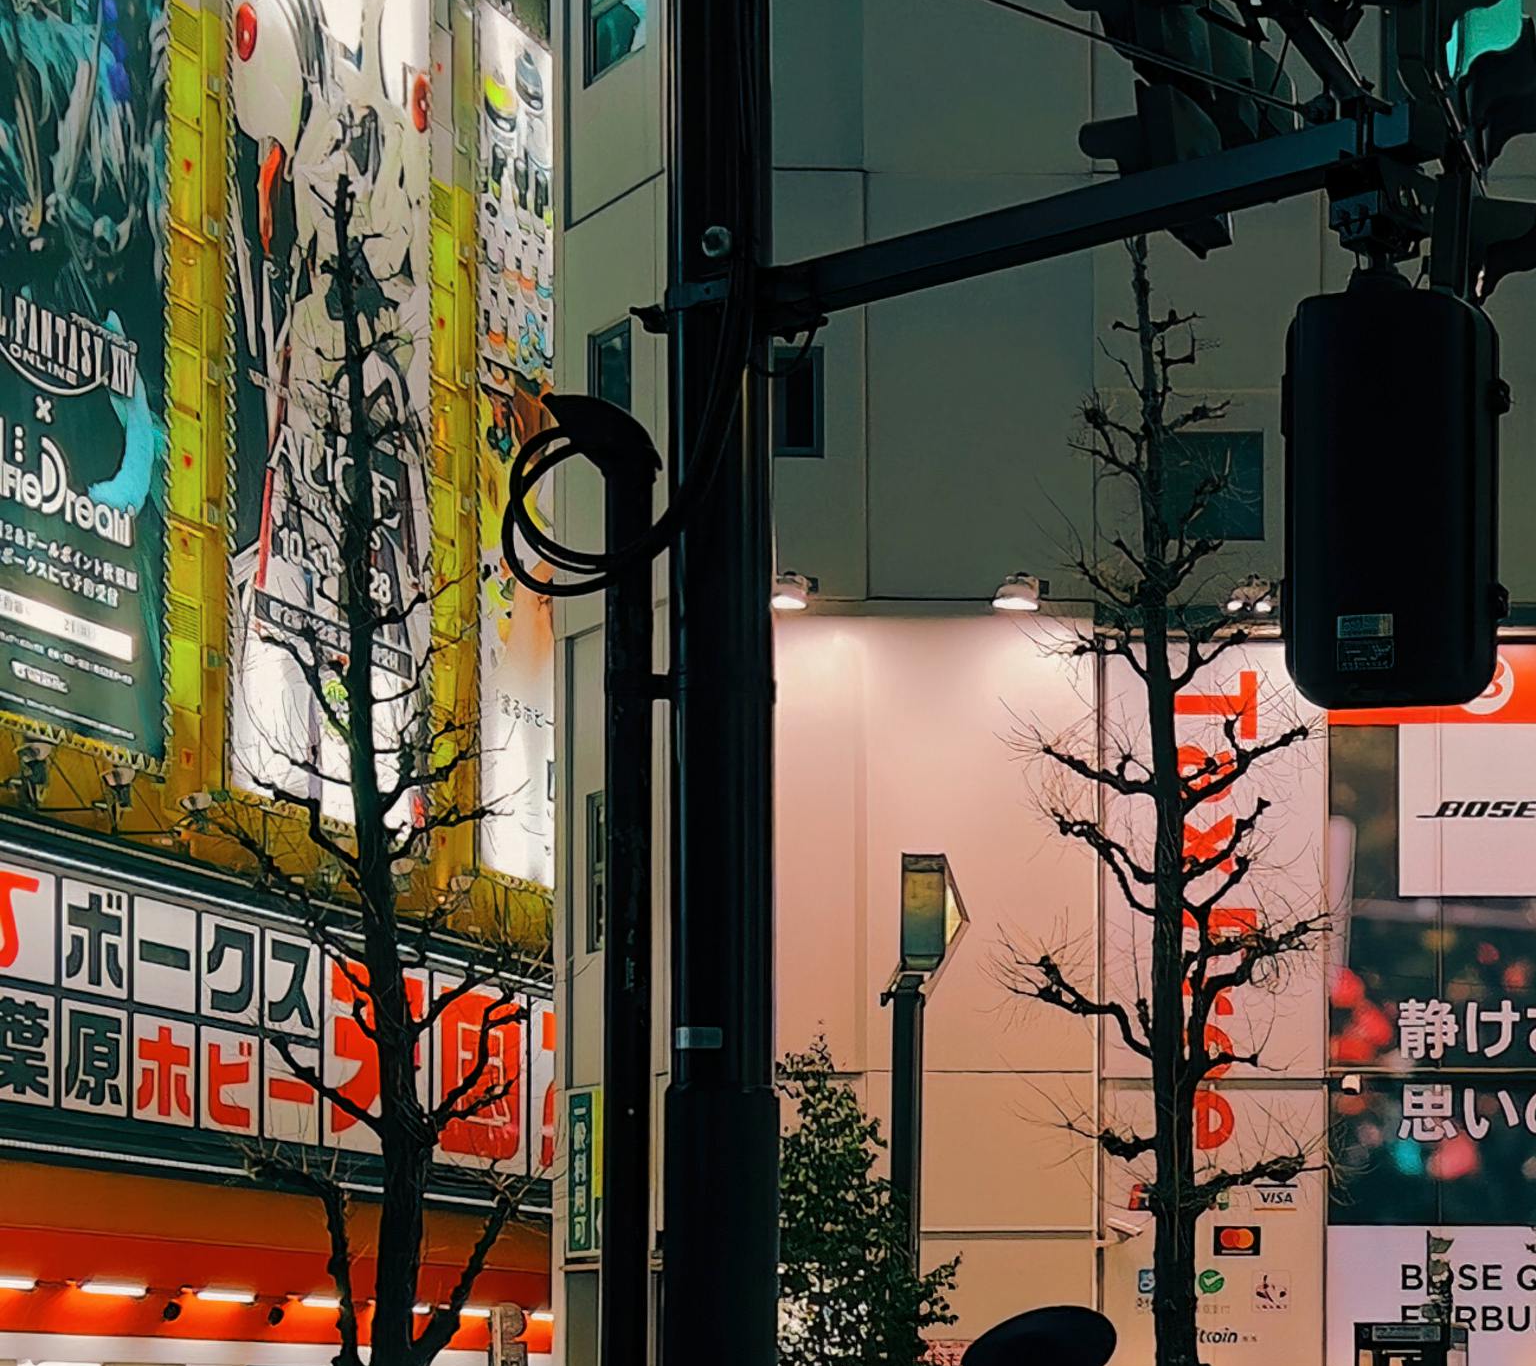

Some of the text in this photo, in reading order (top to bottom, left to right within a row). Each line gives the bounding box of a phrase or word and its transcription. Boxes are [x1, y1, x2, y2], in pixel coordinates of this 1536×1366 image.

[9, 343, 78, 386] ONLINE
[66, 892, 315, 1029] ボークス
[1261, 1191, 1293, 1204] VISA
